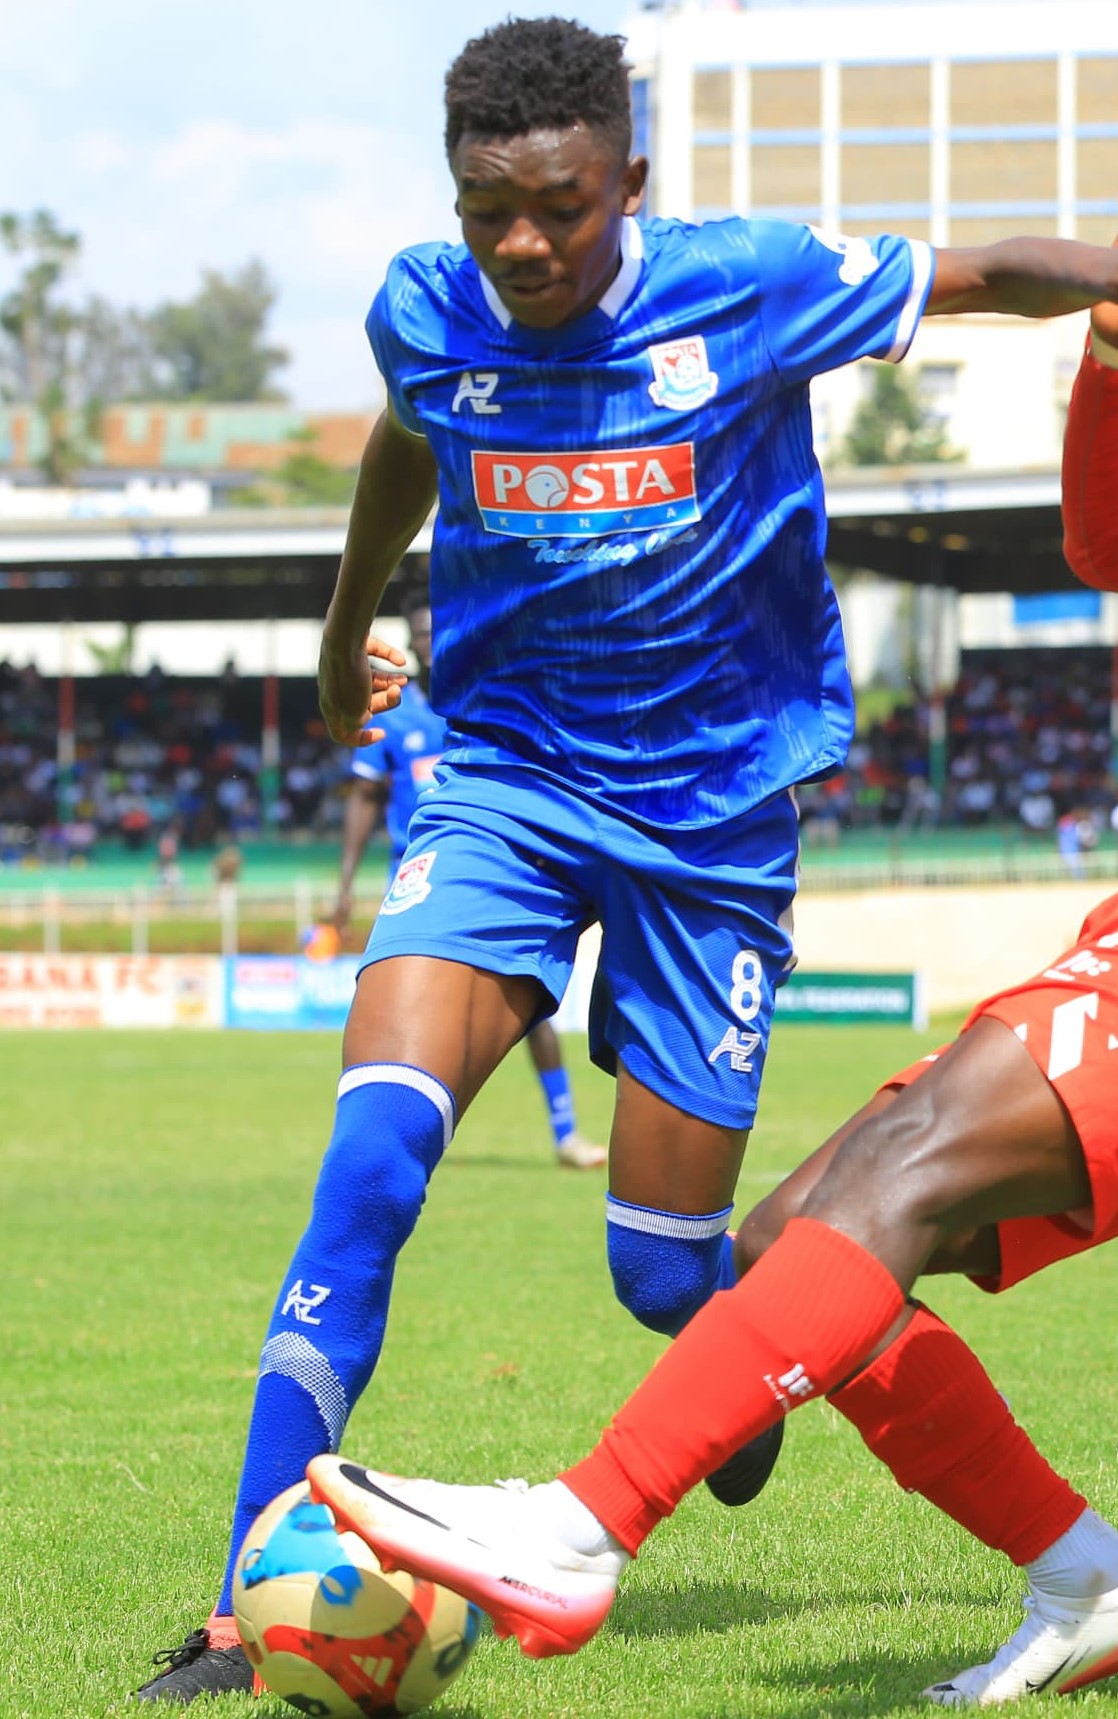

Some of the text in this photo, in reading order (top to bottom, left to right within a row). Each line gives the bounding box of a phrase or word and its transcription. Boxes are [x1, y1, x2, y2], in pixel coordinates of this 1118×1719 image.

[492, 459, 675, 508] POSTA
[499, 507, 677, 530] KENYA
[730, 949, 762, 1021] 8
